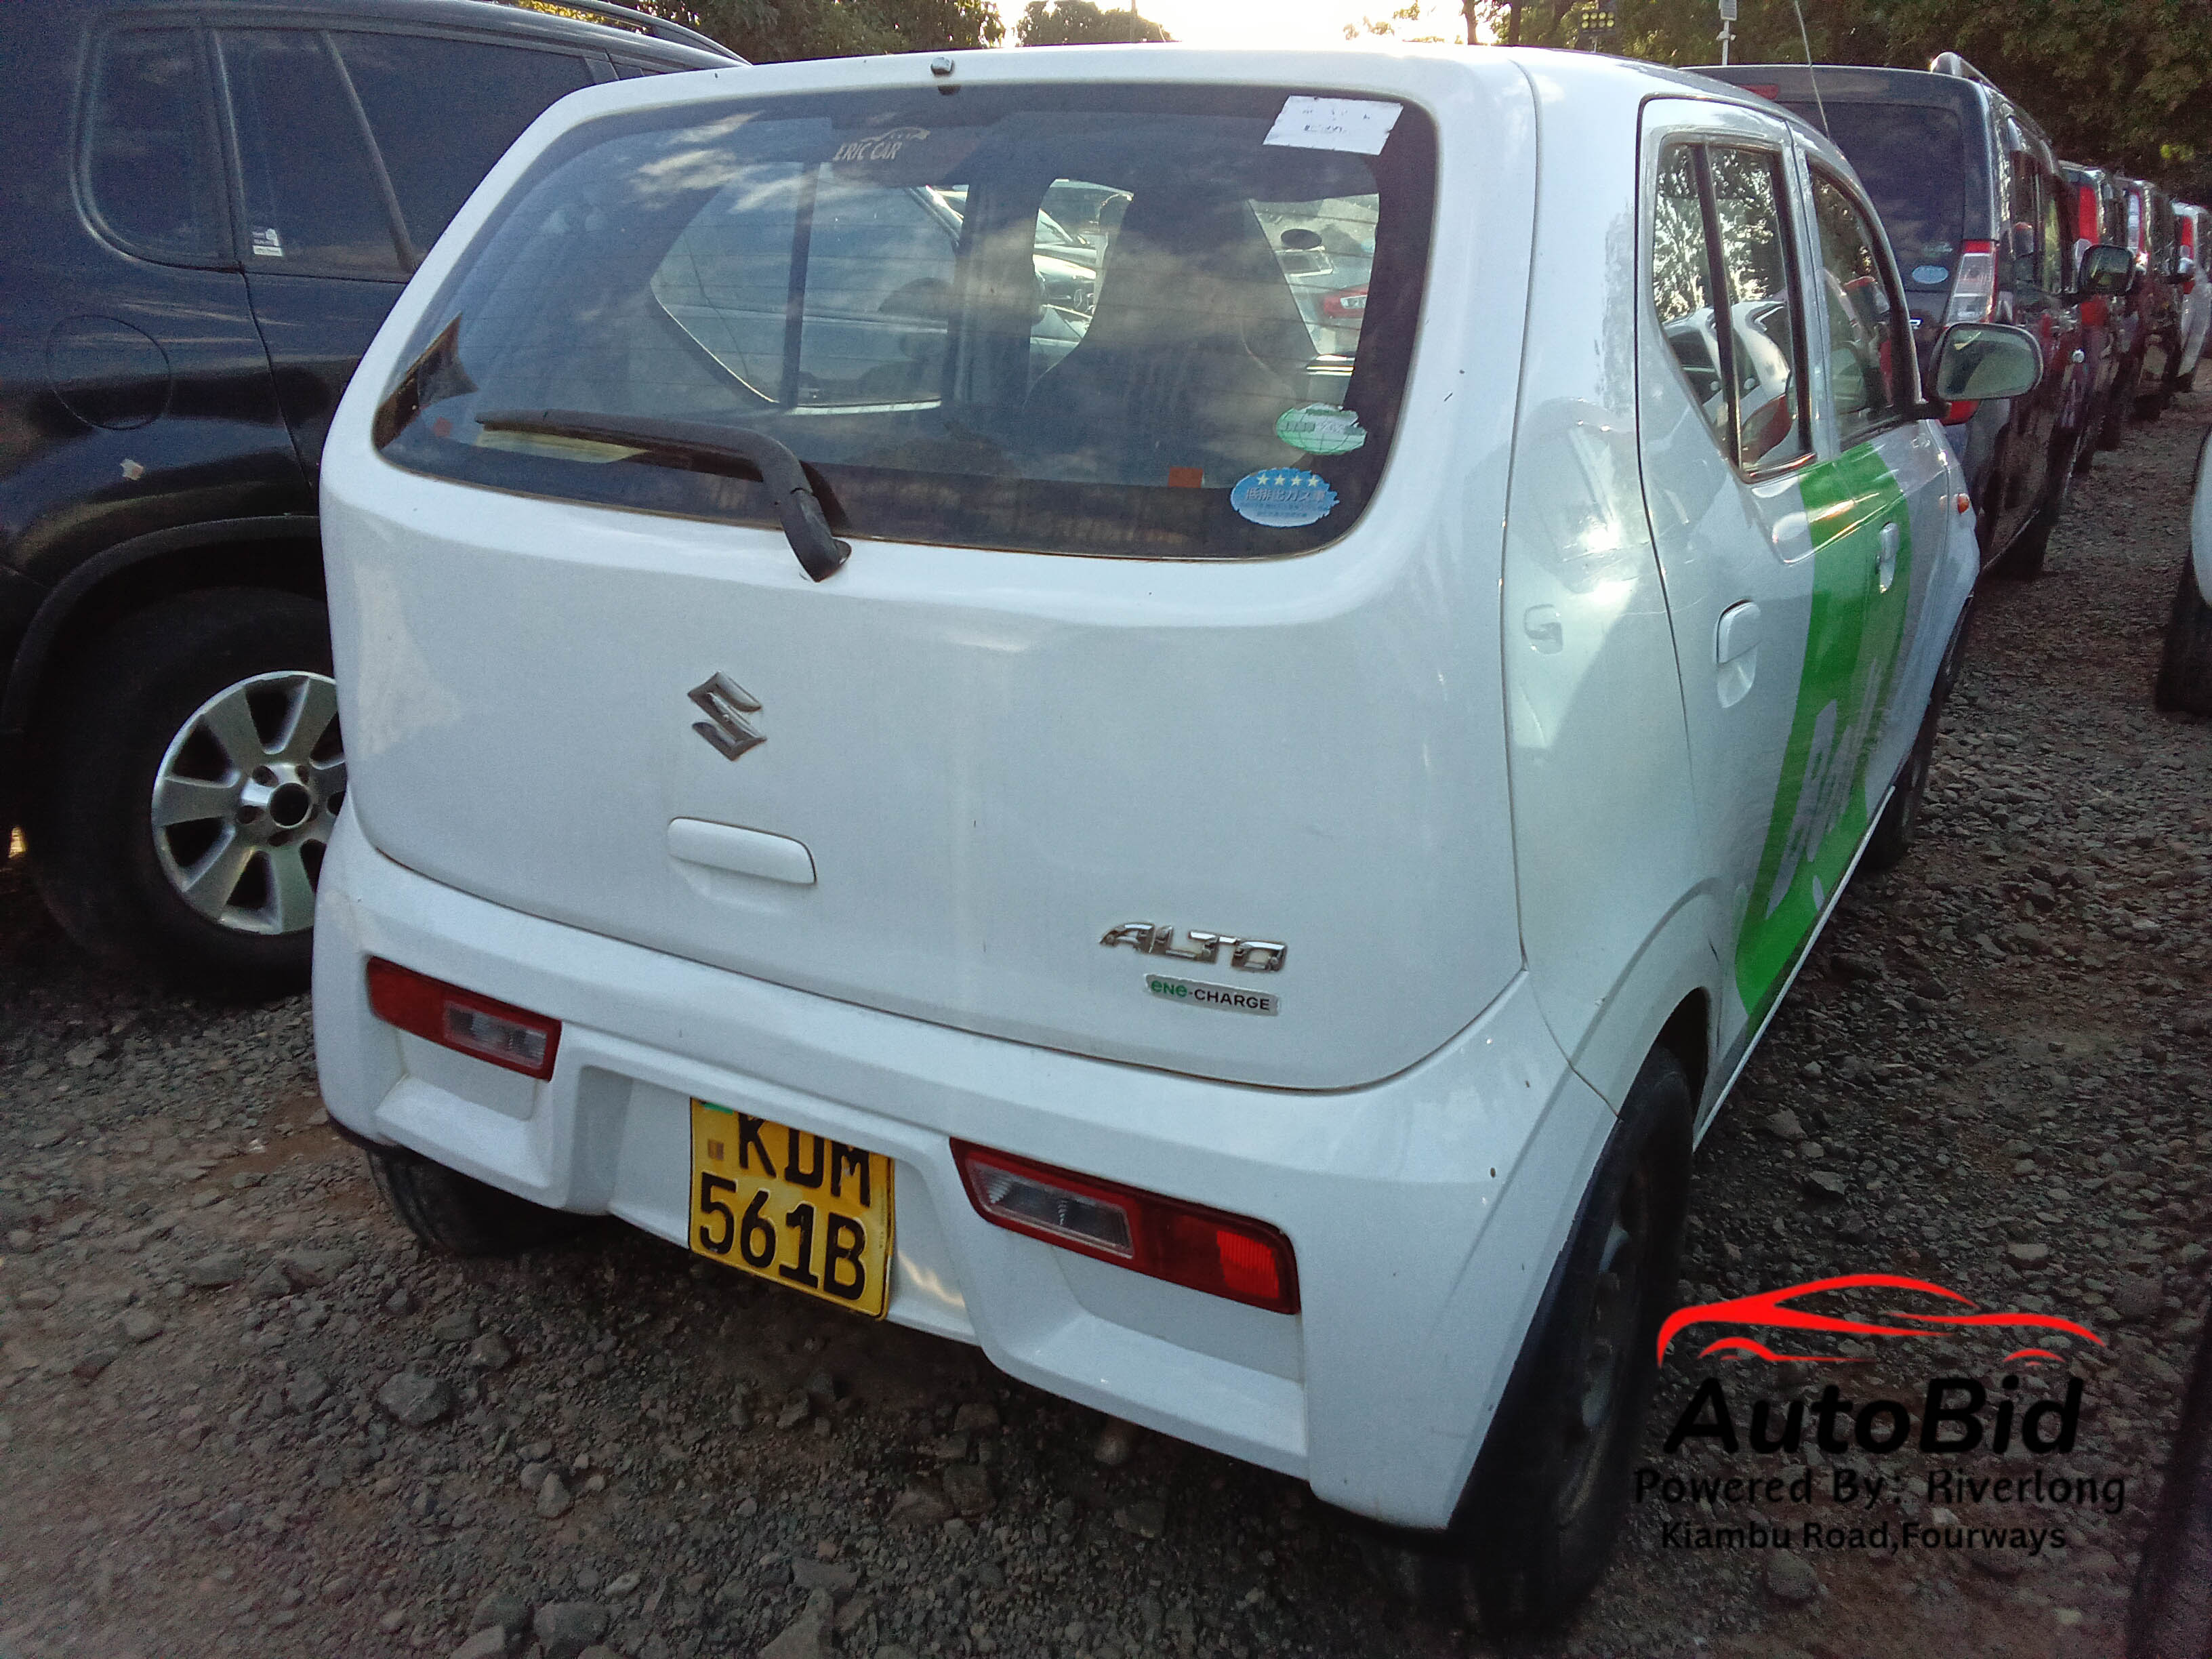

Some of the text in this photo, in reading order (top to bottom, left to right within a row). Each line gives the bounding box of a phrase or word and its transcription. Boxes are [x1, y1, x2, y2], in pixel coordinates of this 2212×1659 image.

[1099, 920, 1287, 972] ALTO
[738, 1112, 871, 1209] KDM
[699, 1171, 867, 1301] 561B
